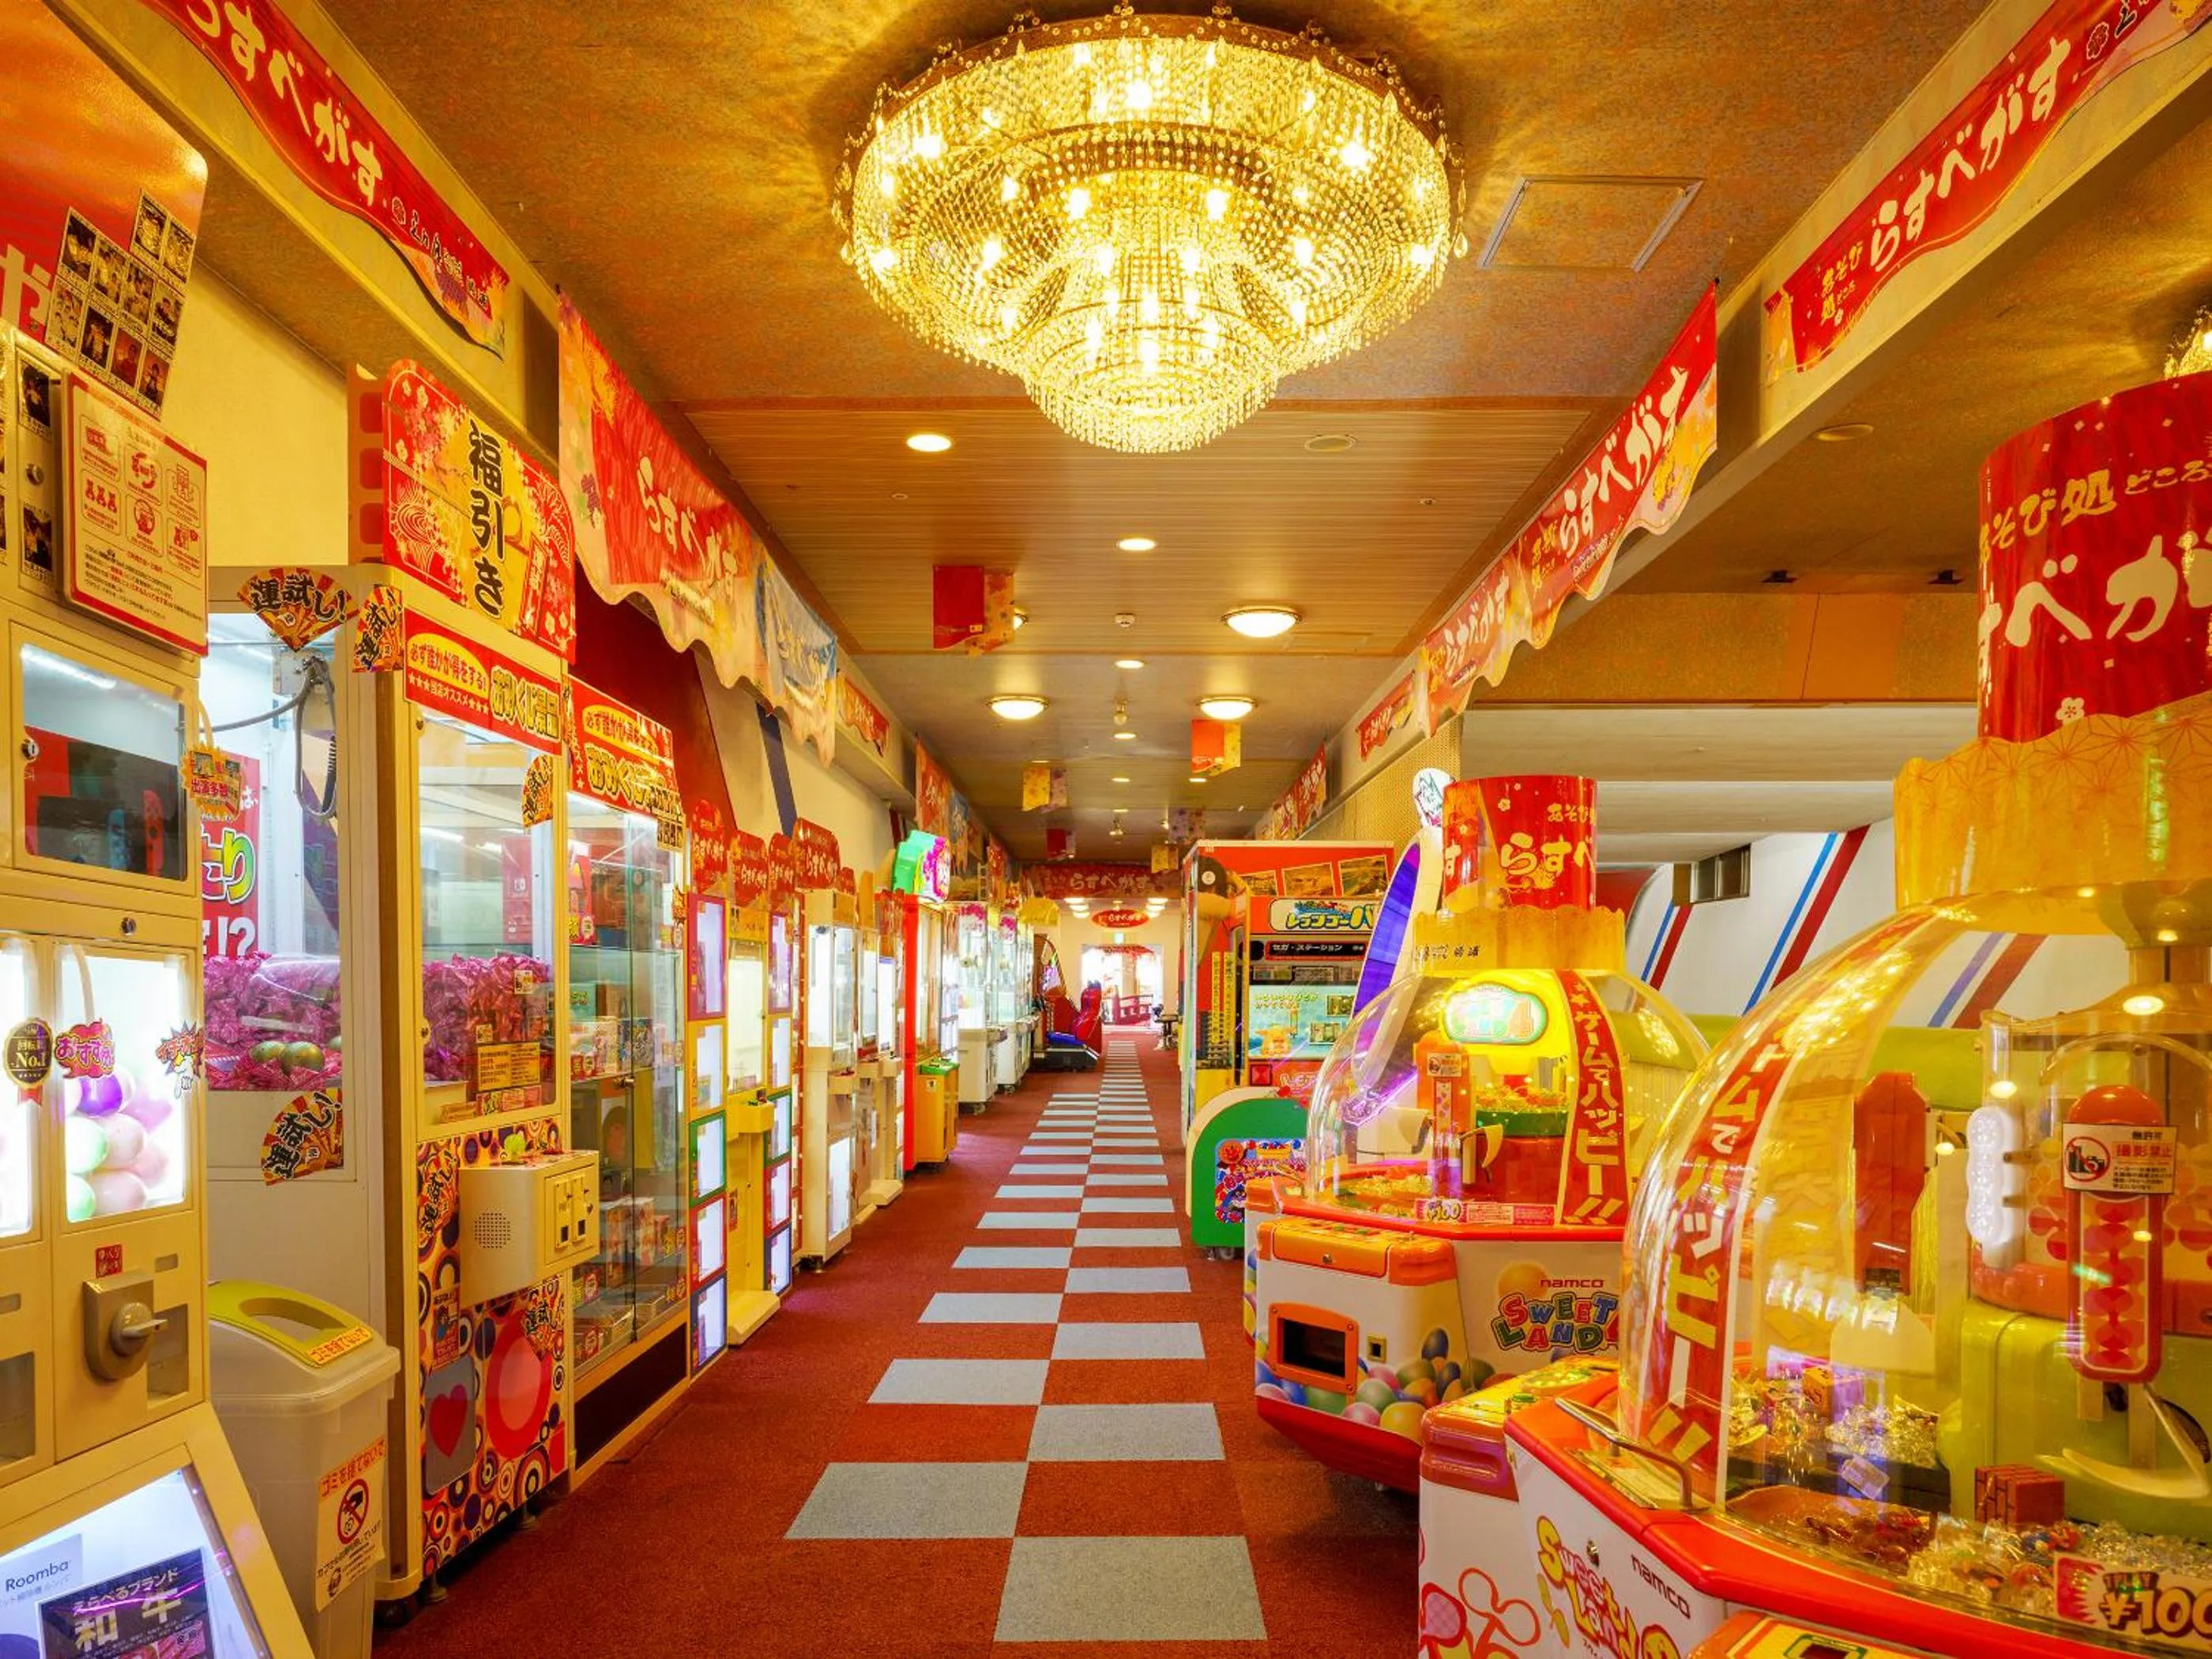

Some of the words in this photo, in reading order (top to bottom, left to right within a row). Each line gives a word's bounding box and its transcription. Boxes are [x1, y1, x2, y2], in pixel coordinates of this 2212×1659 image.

[1870, 37, 2071, 271] らすべがす
[1559, 365, 1688, 558] らすべがす
[468, 419, 505, 619] 福引き
[637, 456, 738, 603] らすべがす
[253, 574, 346, 623] 運試し!
[16, 1051, 46, 1068] No.1
[263, 1092, 342, 1179] 運試し!
[2116, 1144, 2172, 1158] 撮影禁止
[1540, 1278, 1604, 1288] namco
[1648, 1043, 1782, 1463] ームでハッピー!!
[1493, 1318, 1604, 1350] LAND
[1500, 1292, 1619, 1328] SWEET
[6, 1560, 70, 1591] Roomba
[1631, 1554, 1691, 1620] namco
[76, 1589, 182, 1653] 和牛
